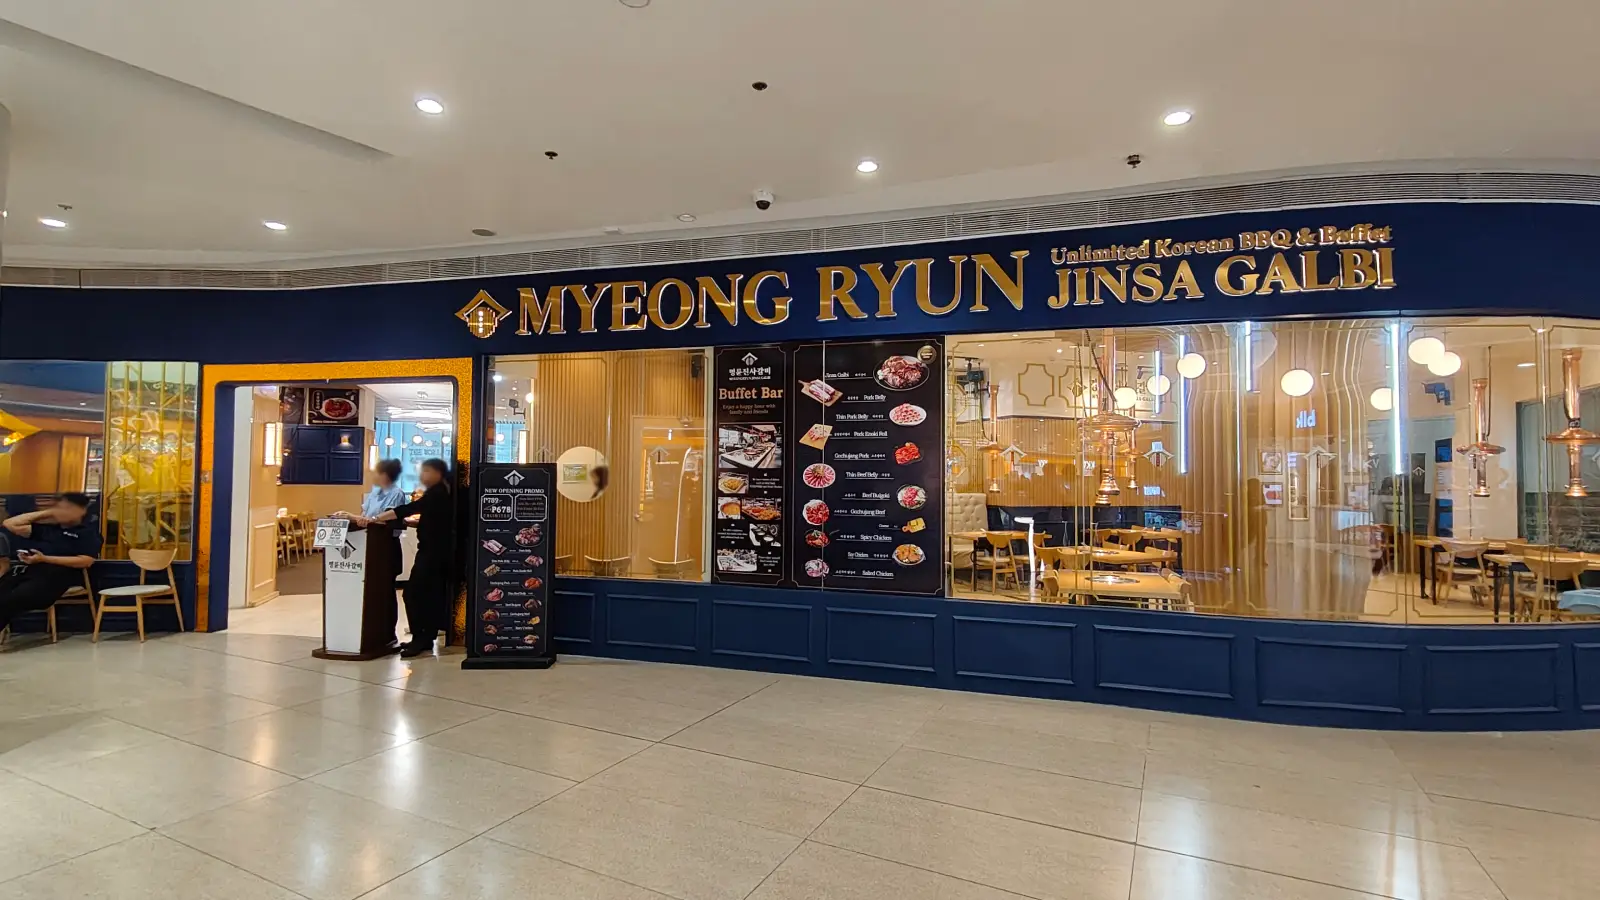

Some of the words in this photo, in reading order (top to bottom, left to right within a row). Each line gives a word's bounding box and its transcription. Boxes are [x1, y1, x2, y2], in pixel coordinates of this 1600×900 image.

[1051, 239, 1150, 265] Unlimited
[1155, 237, 1234, 258] Korean
[1239, 228, 1294, 250] BBQ
[1295, 227, 1316, 247] &
[1319, 223, 1392, 245] Buffet
[515, 270, 792, 335] MYEONG
[816, 250, 1030, 322] RYUN
[1047, 259, 1205, 309] JINSA
[1214, 247, 1397, 297] GALBI
[719, 387, 758, 400] Buffet
[761, 387, 783, 399] Bar
